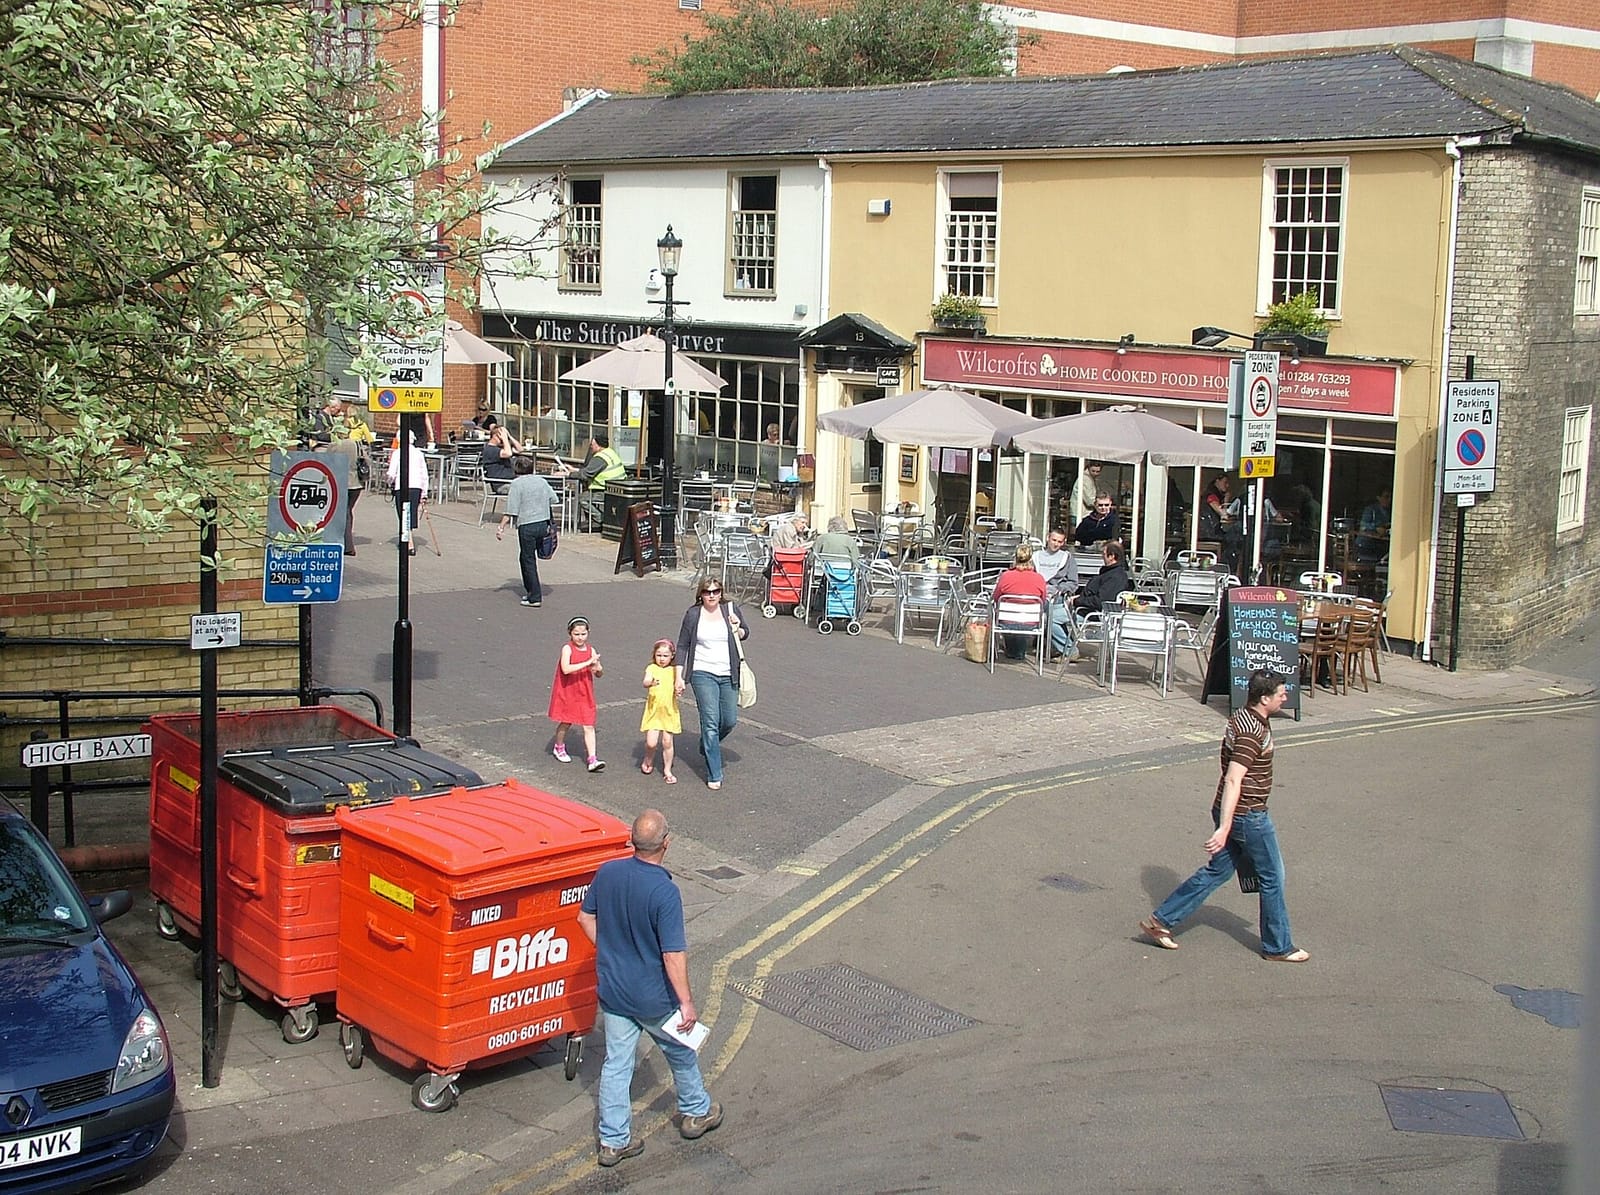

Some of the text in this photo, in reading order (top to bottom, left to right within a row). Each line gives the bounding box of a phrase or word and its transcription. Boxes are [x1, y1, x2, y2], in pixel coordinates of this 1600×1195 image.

[539, 320, 572, 342] The
[855, 332, 864, 342] 13
[383, 357, 430, 366] loading by
[1248, 352, 1277, 361] PEDESTRIAN
[957, 350, 1037, 377] Wilcrofts
[1060, 366, 1098, 380] HOME
[1102, 368, 1157, 384] COOKED
[1161, 372, 1198, 387] FOOD
[1252, 362, 1273, 373] ZONE
[1278, 370, 1351, 385] el 01284 763293
[405, 390, 434, 400] At any
[1278, 384, 1350, 398] pen 7 days a week
[1452, 387, 1495, 397] Residents
[409, 400, 429, 408] time
[1457, 399, 1490, 409] Parking
[1453, 410, 1492, 423] ZONE A
[1248, 422, 1264, 431] Except
[305, 549, 325, 559] limit
[328, 551, 339, 559] on
[269, 560, 339, 571] Orchard Street
[304, 573, 332, 583] ahead
[1239, 591, 1275, 601] Wilcrofts
[1233, 606, 1278, 618] HOMEMADE
[195, 617, 237, 626] No loading
[1235, 618, 1277, 631] FRESH COD
[1252, 629, 1298, 645] AND CHIPS
[29, 736, 151, 764] HIGH BAXT
[470, 883, 592, 926] MIXED RECYC
[491, 926, 569, 980] Biffa
[489, 979, 566, 1015] RECYCLING
[28, 1131, 72, 1159] NVK
